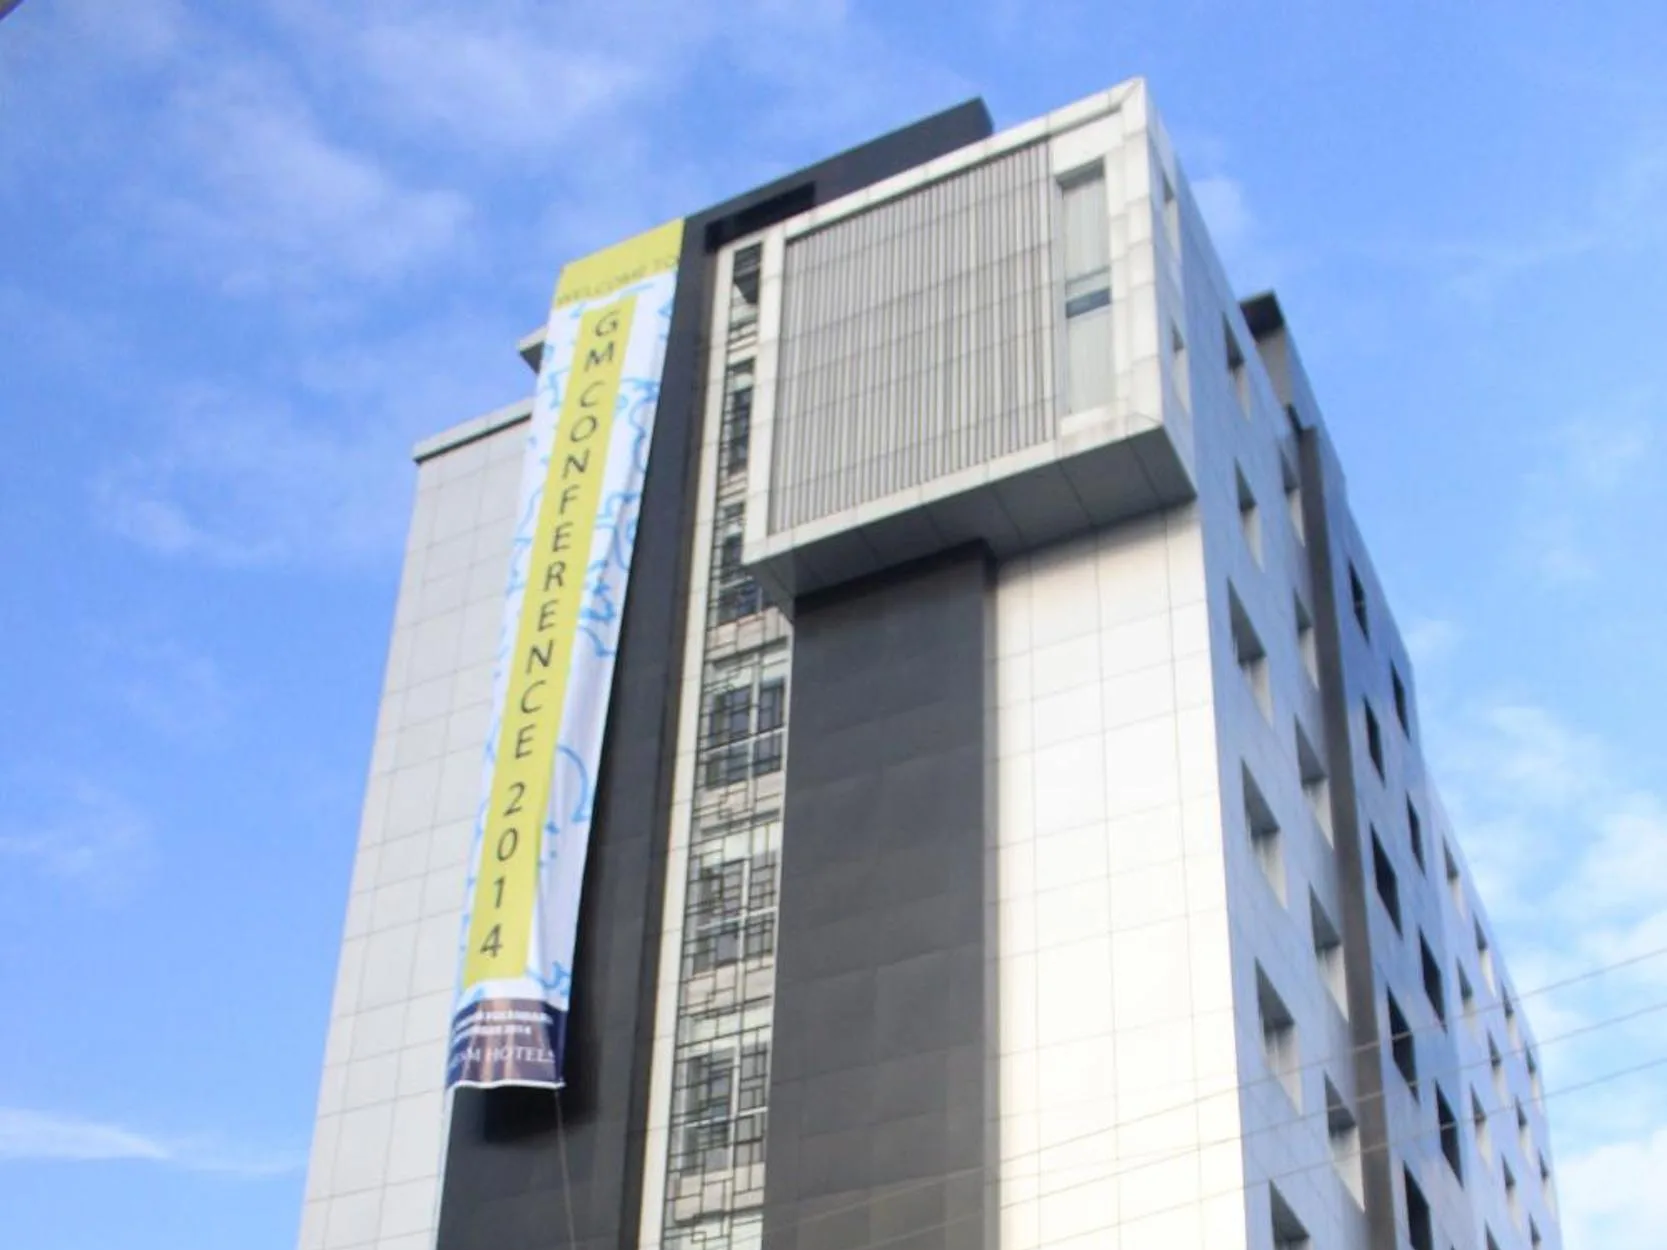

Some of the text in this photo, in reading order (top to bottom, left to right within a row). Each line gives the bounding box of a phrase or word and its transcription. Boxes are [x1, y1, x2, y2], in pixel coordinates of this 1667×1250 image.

[480, 309, 619, 958] GM CONFERENCE 2014
